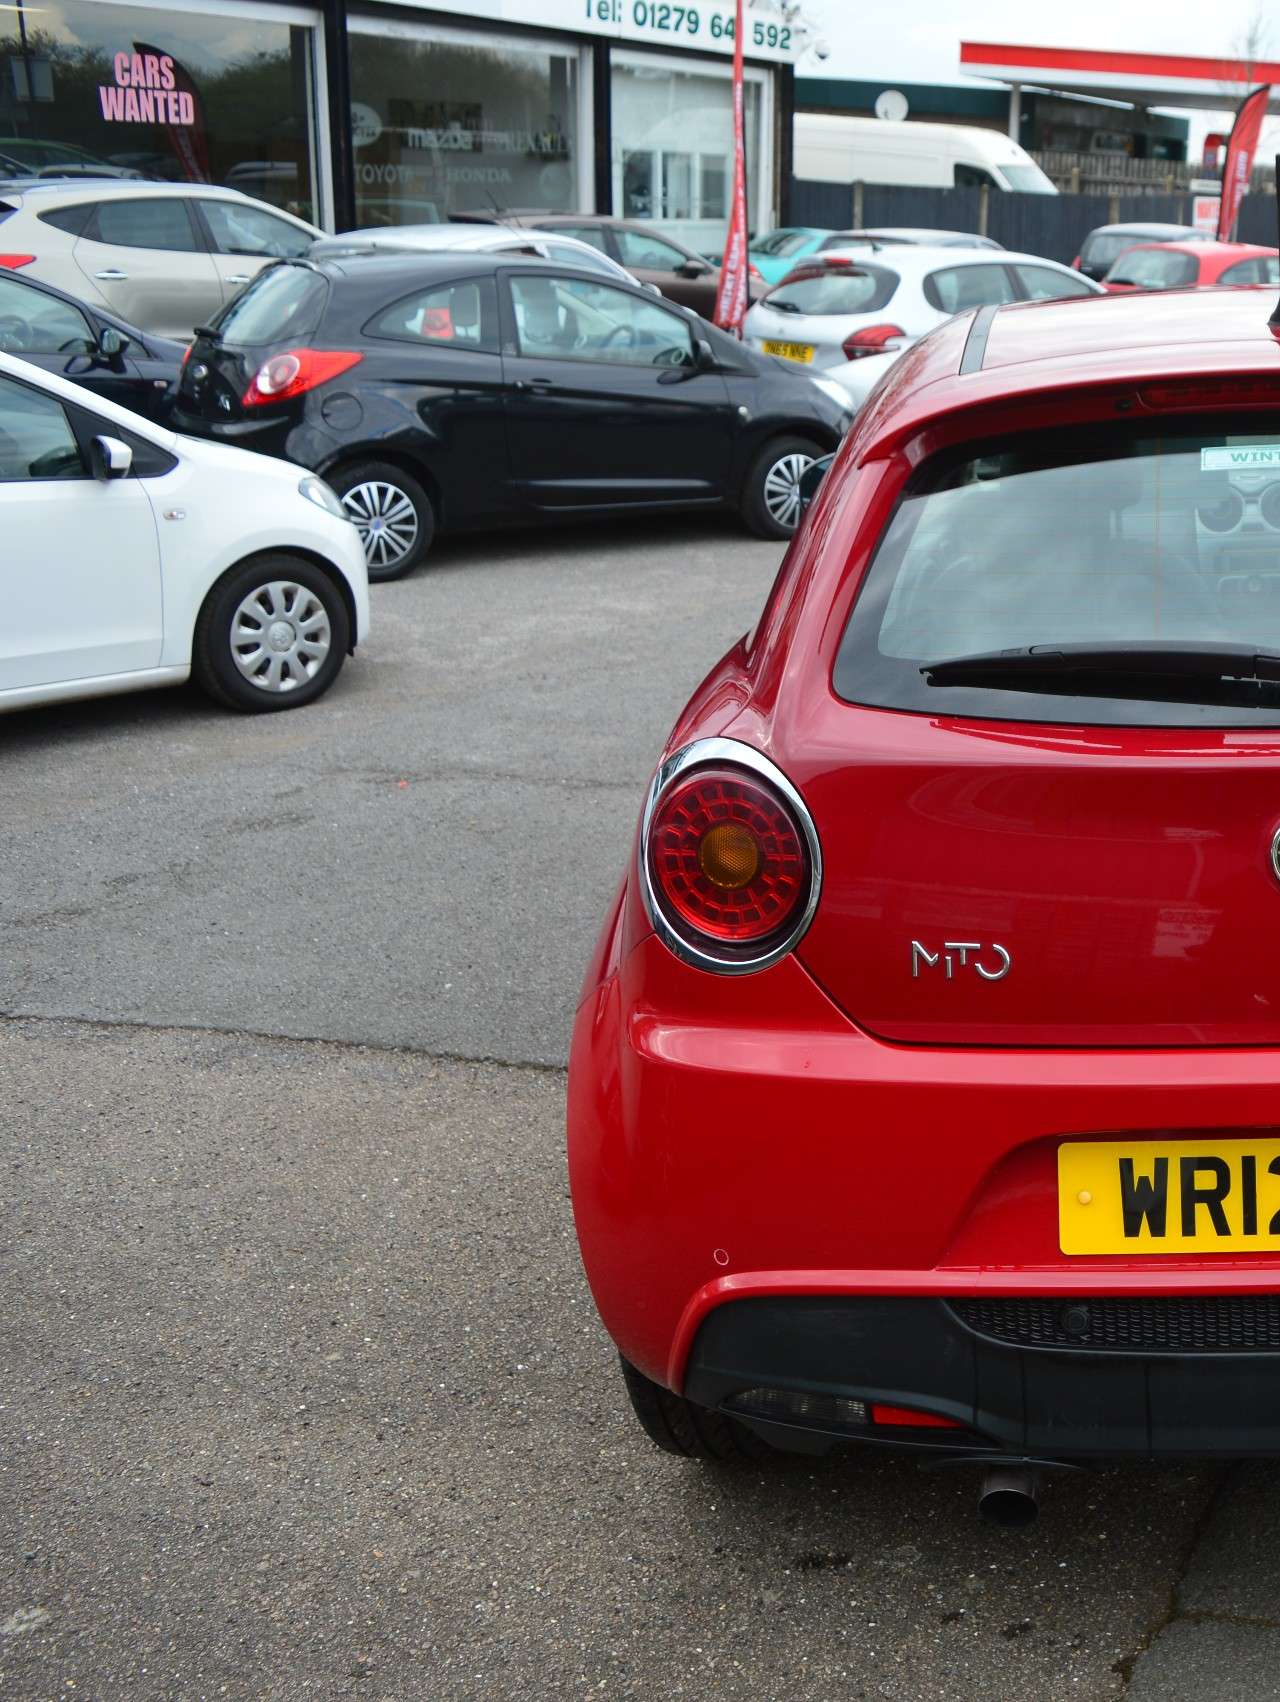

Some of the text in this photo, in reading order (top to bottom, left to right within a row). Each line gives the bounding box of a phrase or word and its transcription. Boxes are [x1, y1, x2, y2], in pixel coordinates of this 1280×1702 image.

[633, 1, 700, 34] 01279
[710, 14, 742, 40] 64
[753, 21, 792, 50] 592
[114, 51, 176, 90] CARS
[99, 86, 194, 125] WANTED
[449, 166, 512, 184] HONDA
